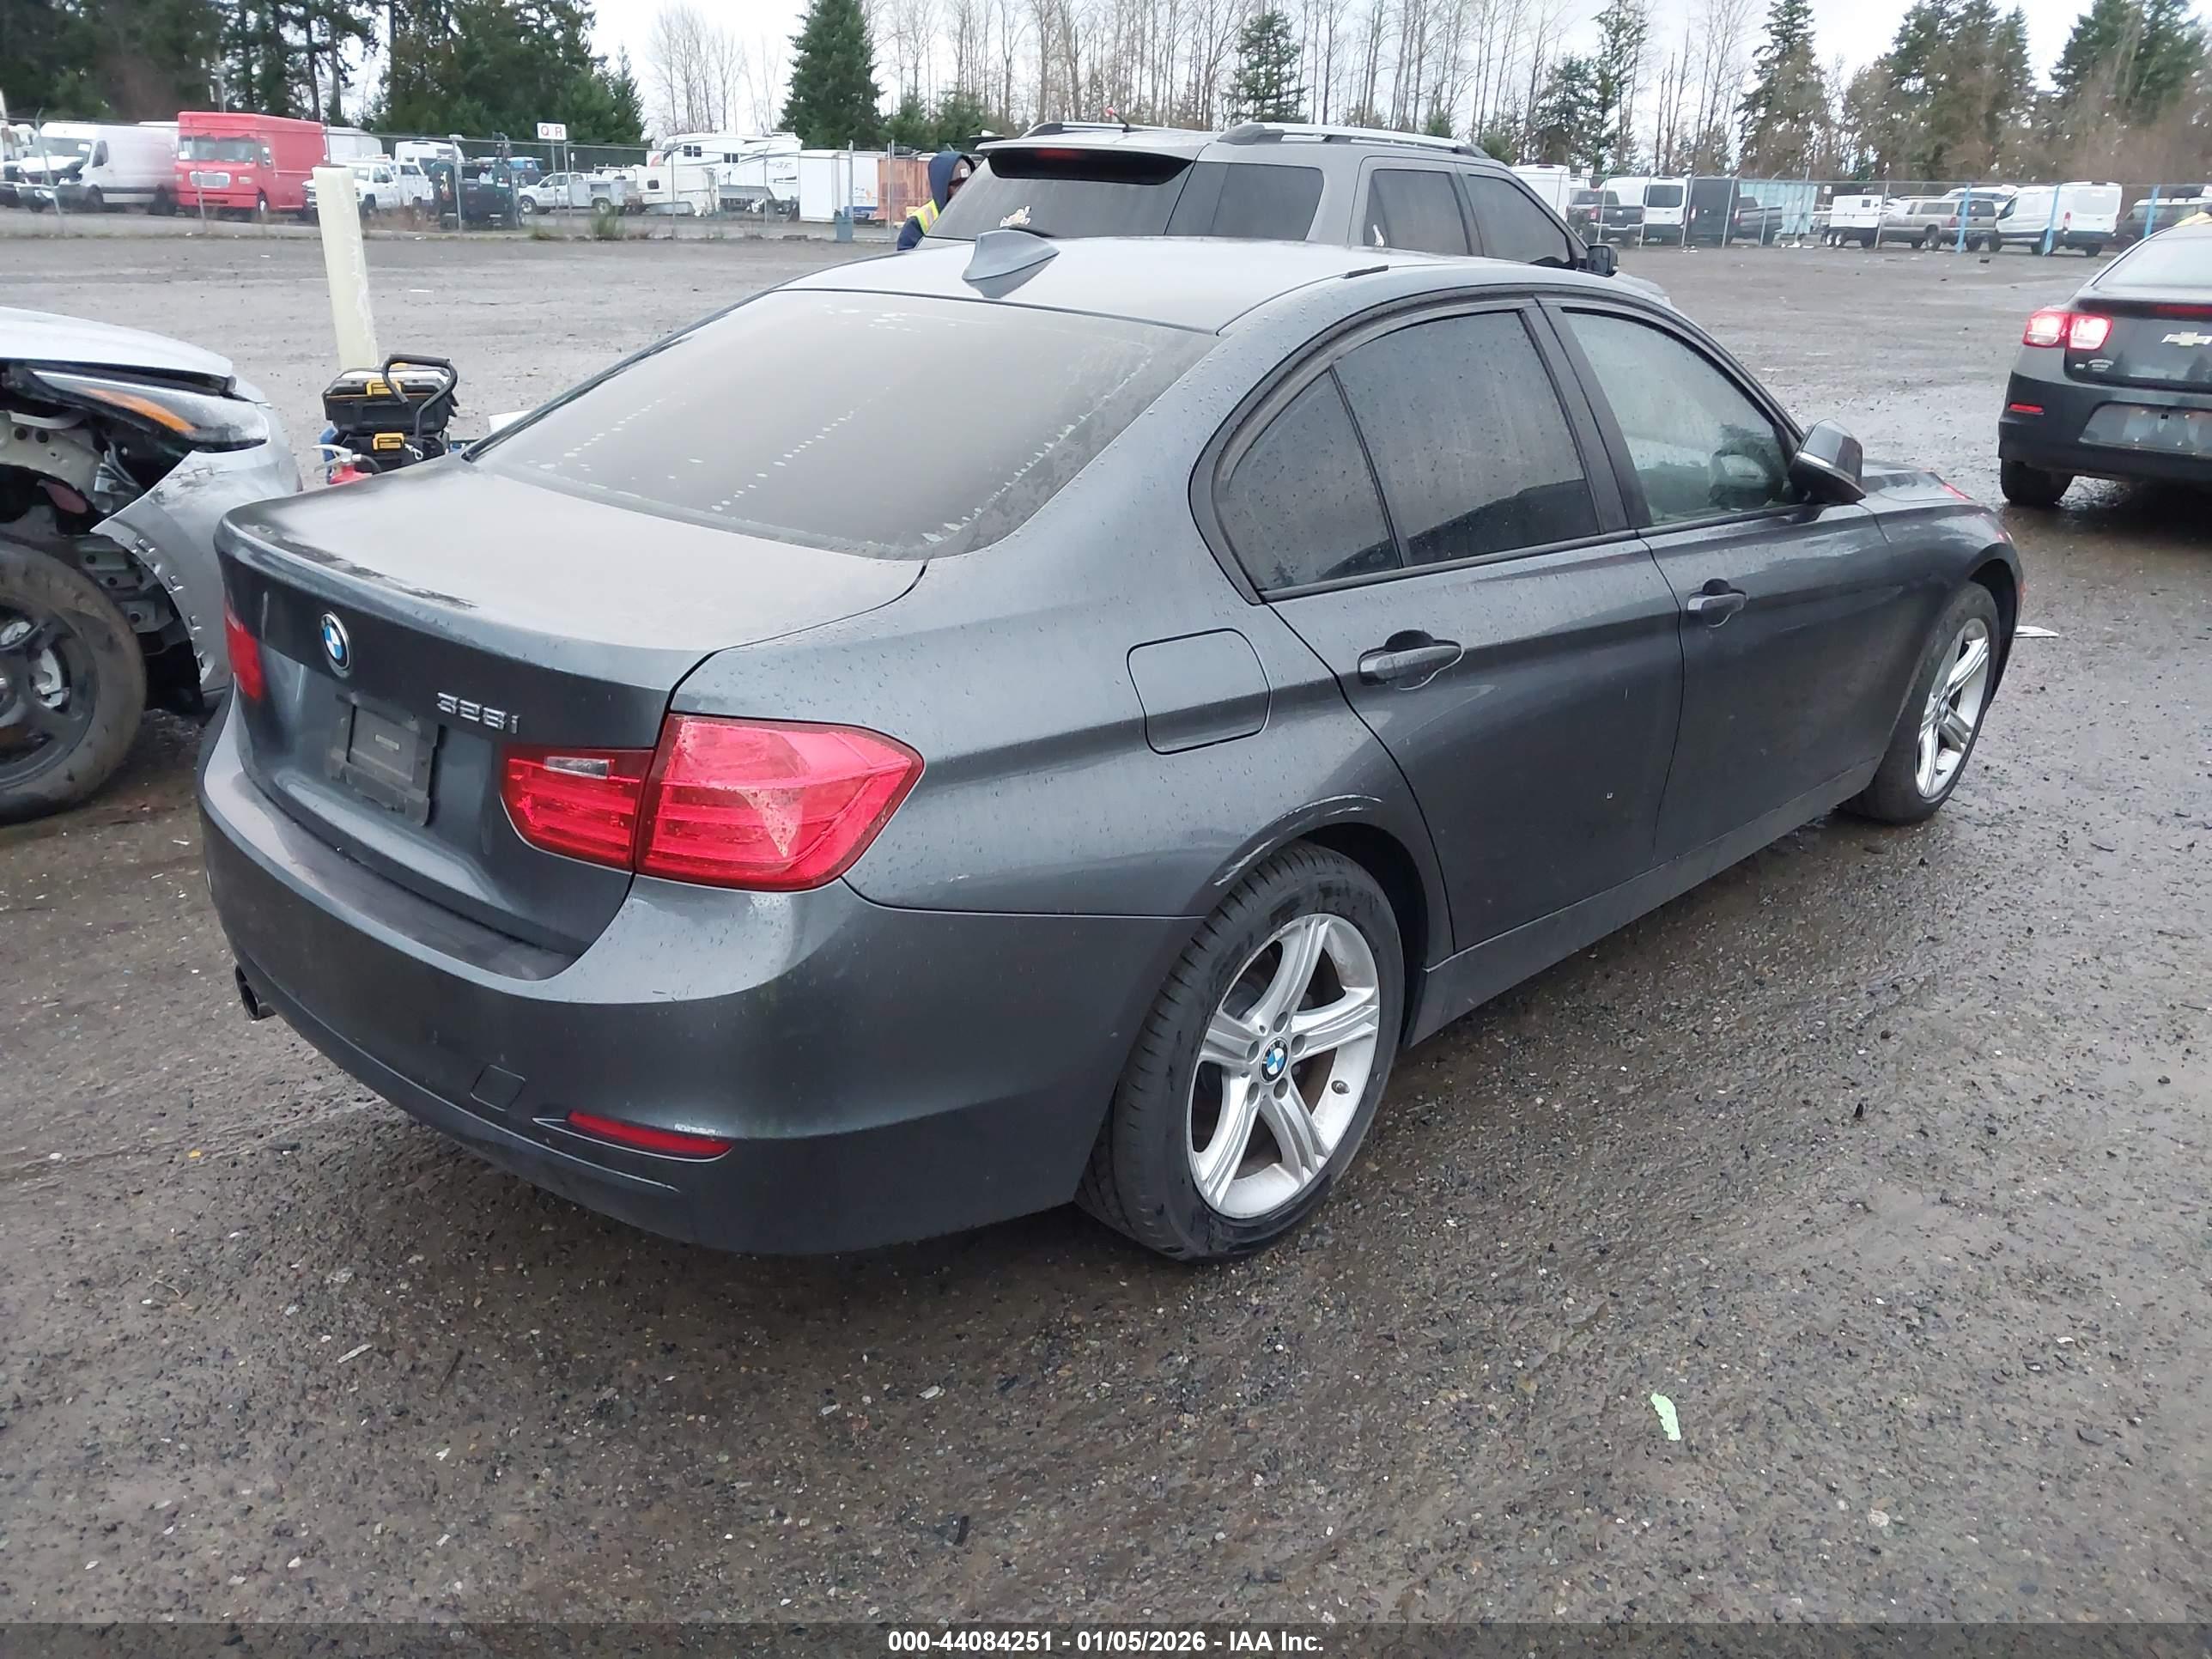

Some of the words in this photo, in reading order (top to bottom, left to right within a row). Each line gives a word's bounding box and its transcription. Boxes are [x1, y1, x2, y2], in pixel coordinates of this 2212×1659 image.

[541, 125, 550, 137] Q
[555, 126, 562, 137] R
[435, 692, 520, 734] 328i
